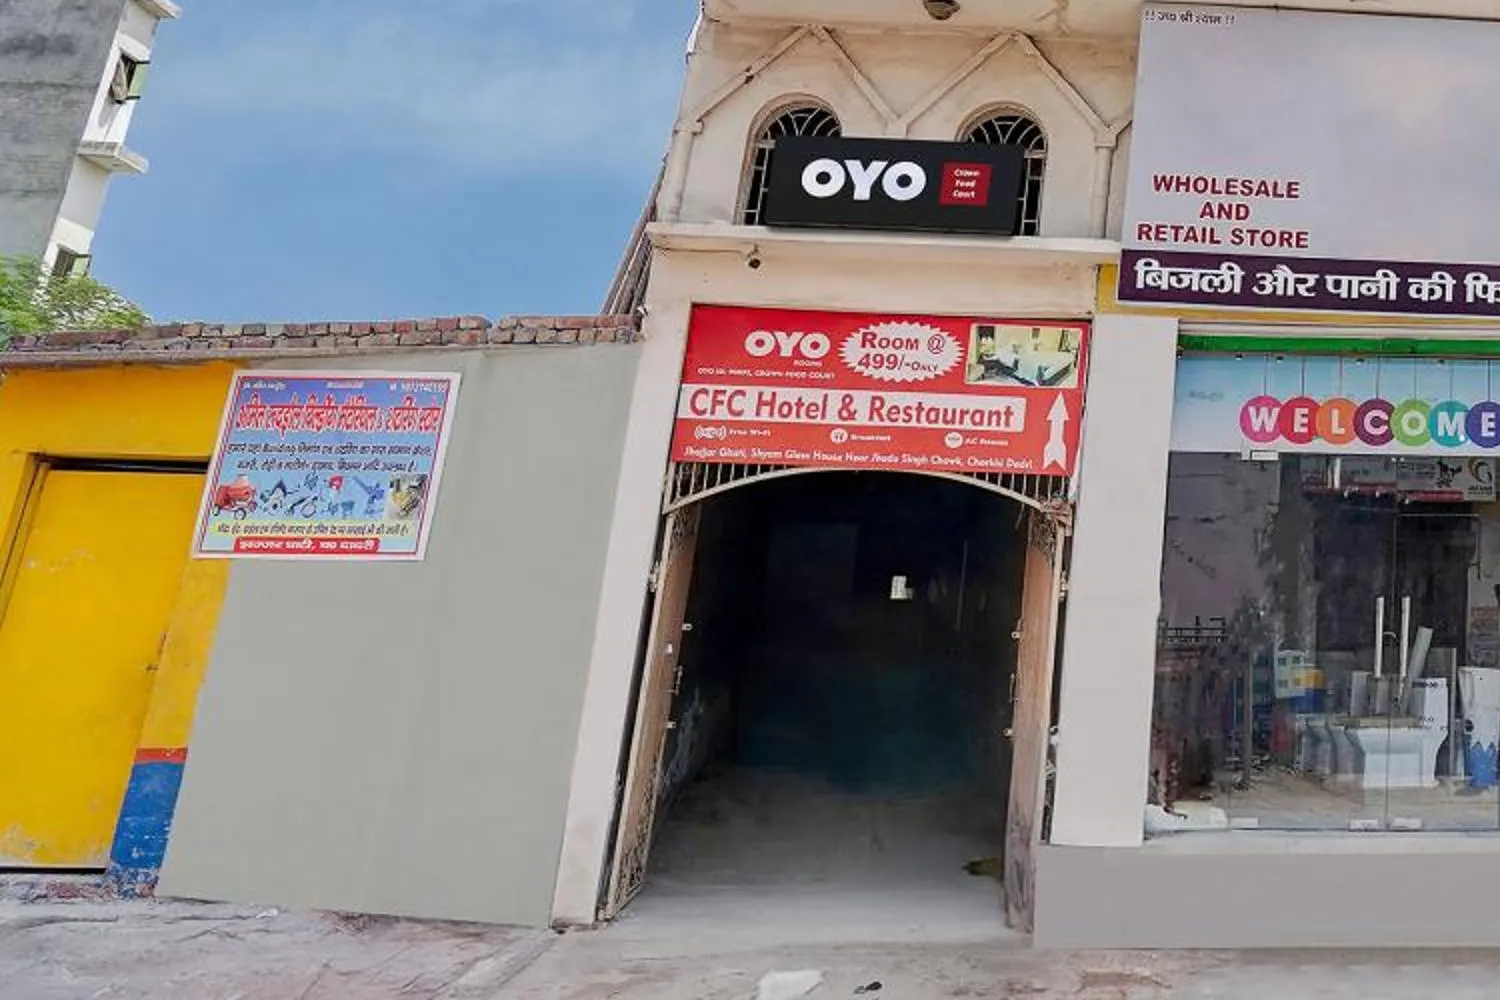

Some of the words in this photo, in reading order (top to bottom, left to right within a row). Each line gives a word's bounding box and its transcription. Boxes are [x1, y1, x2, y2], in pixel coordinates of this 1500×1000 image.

[801, 158, 927, 201] OYO
[1153, 175, 1300, 199] WHOLESALE
[1199, 202, 1250, 221] AND
[1137, 224, 1221, 245] RETAIL
[1230, 228, 1309, 249] STORE
[1134, 257, 1245, 295] बिजली
[1252, 263, 1319, 298] और
[1325, 269, 1400, 300] पानी
[1408, 271, 1457, 302] की
[744, 330, 831, 359] OYO
[927, 334, 946, 354] @
[690, 388, 745, 418] CFC
[755, 392, 828, 421] Hotel
[837, 396, 858, 422] &
[868, 397, 1015, 428] Restaurant
[1248, 406, 1498, 438] WELCOME
